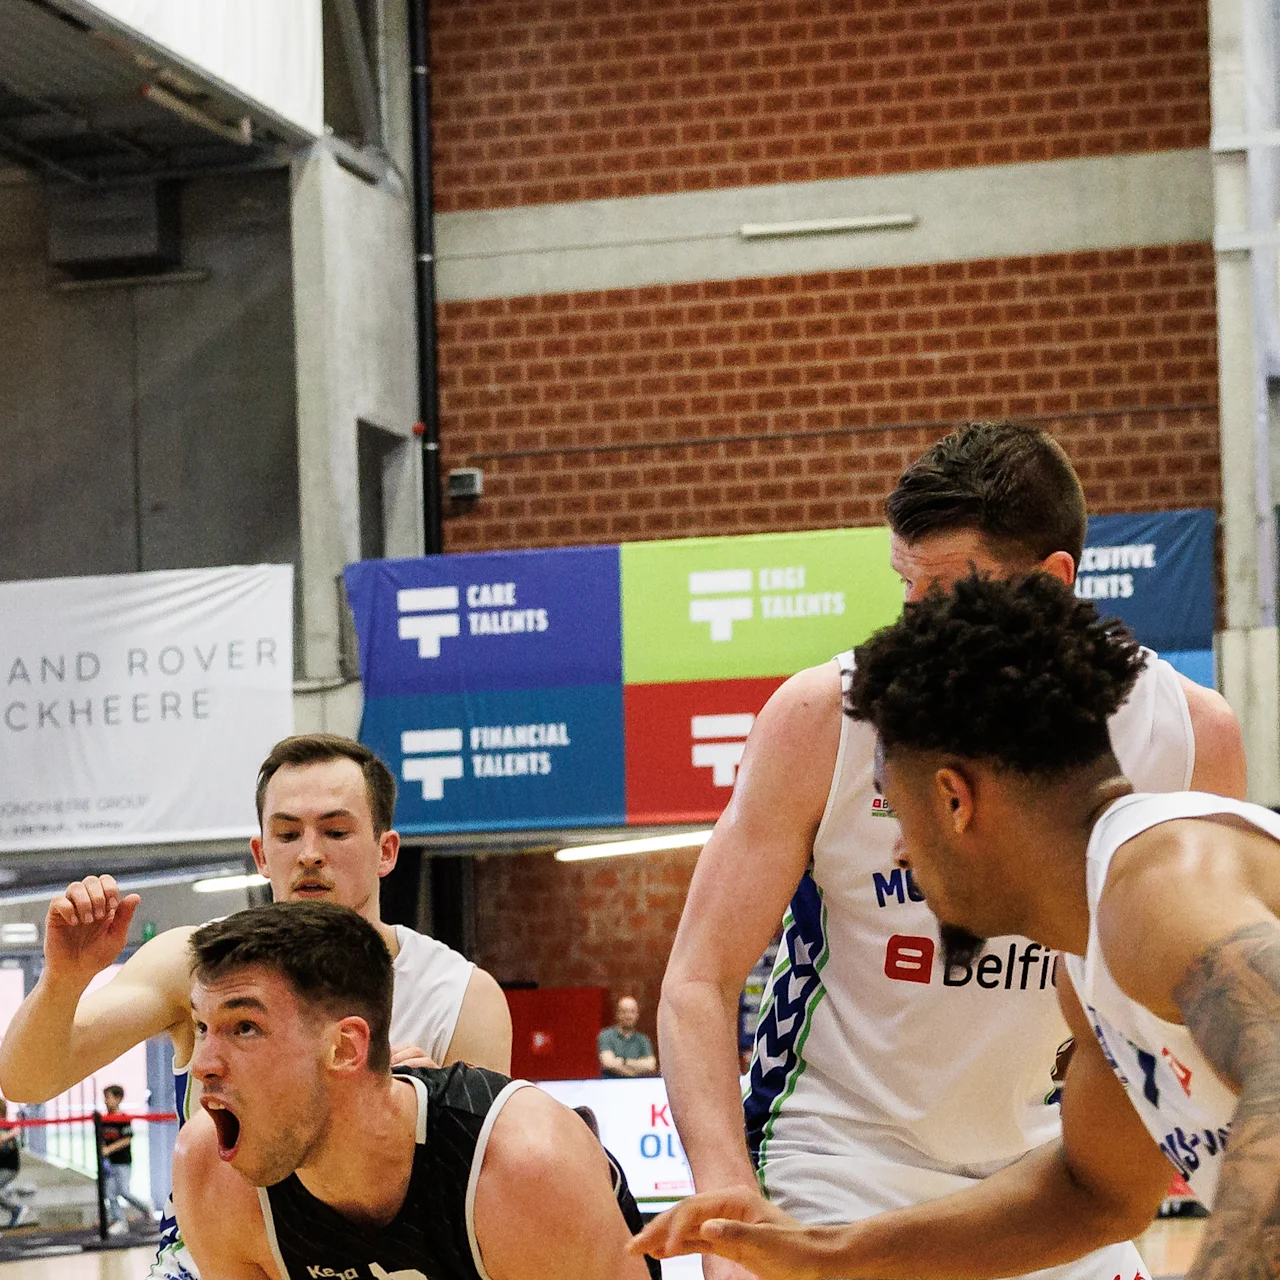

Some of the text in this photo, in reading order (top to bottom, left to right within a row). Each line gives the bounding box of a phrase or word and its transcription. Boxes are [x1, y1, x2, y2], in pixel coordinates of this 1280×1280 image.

[467, 582, 516, 608] CARE
[761, 591, 846, 619] TALENTS
[469, 608, 549, 636] TALENTS
[128, 636, 278, 678] ROVER
[470, 722, 571, 751] FINANCIAL
[472, 751, 552, 778] TALENTS
